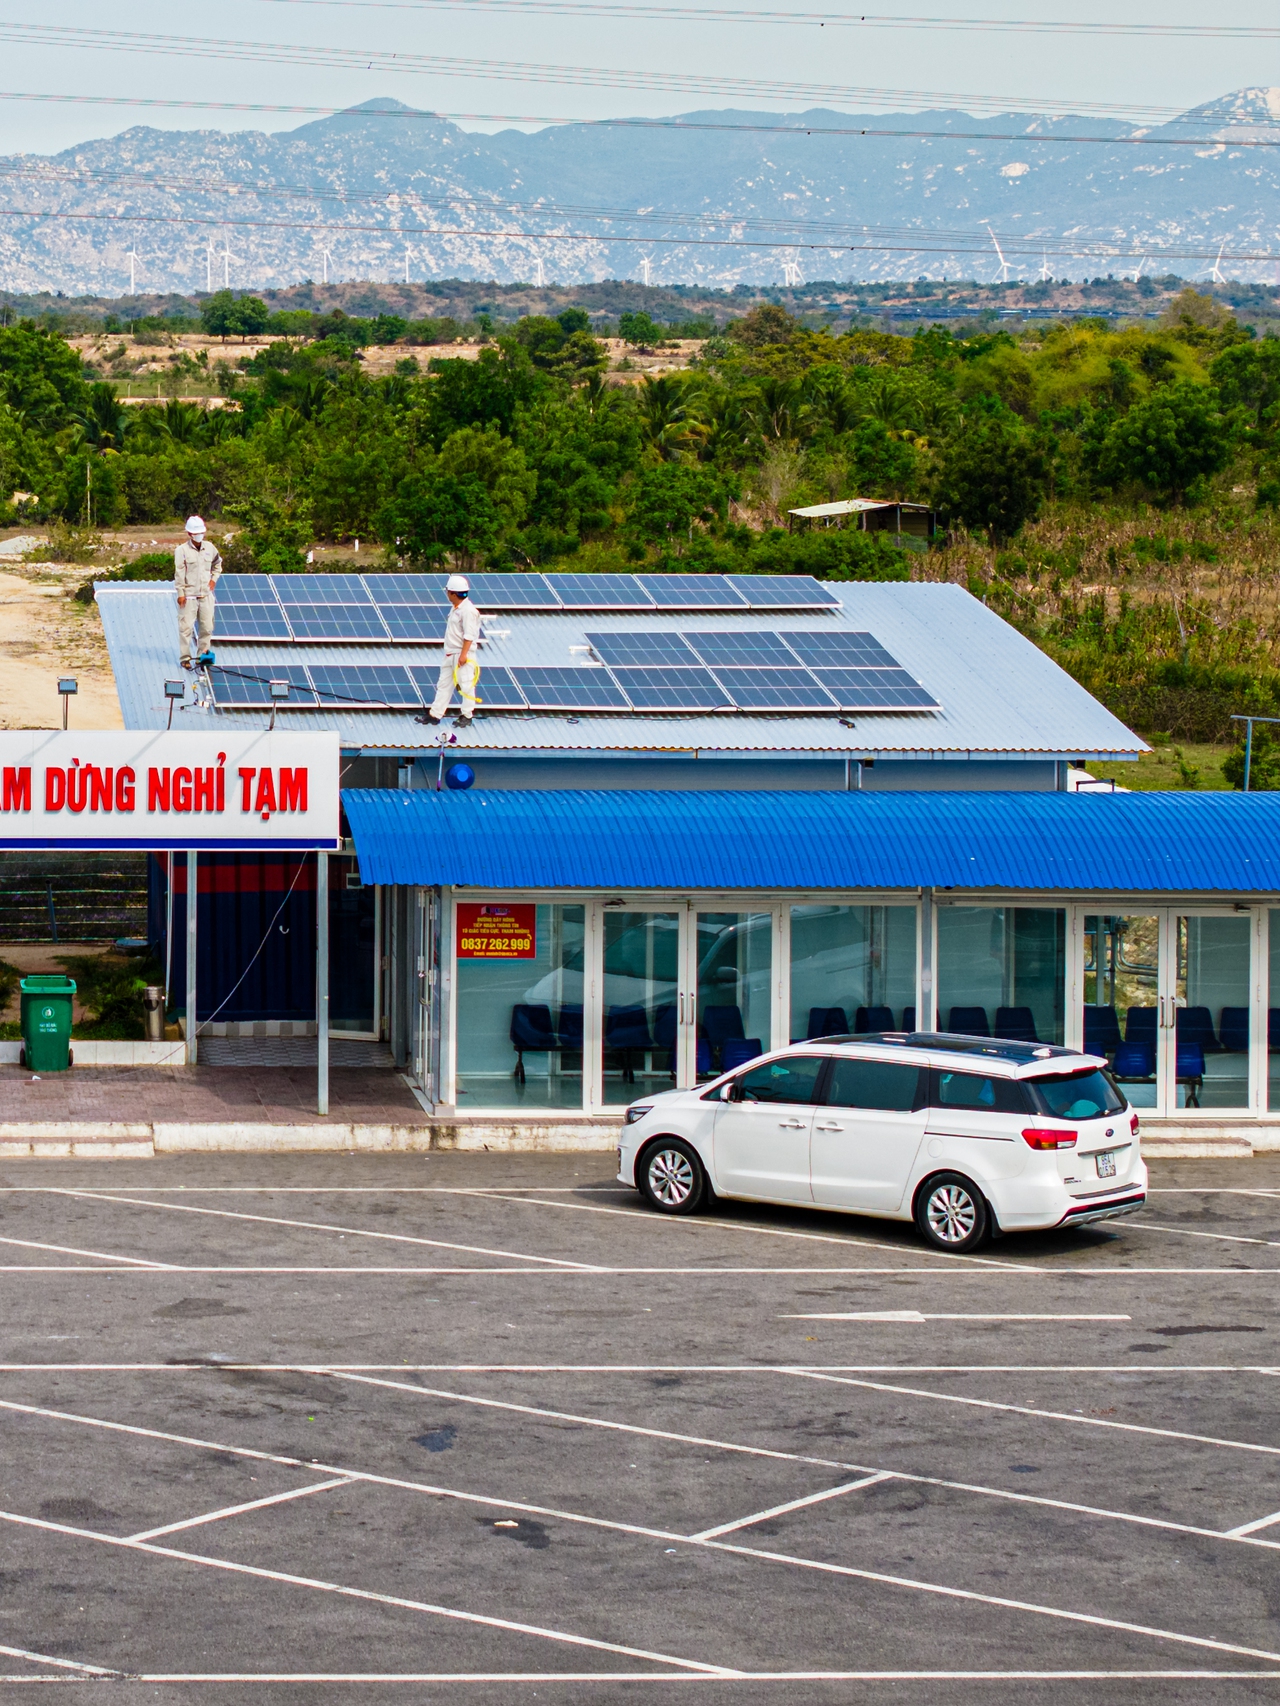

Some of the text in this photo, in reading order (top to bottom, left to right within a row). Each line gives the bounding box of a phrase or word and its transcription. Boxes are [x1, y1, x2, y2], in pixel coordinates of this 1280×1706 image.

[45, 757, 136, 813] DỪNG
[148, 751, 227, 812] NGHỈ
[238, 766, 309, 821] TẠM
